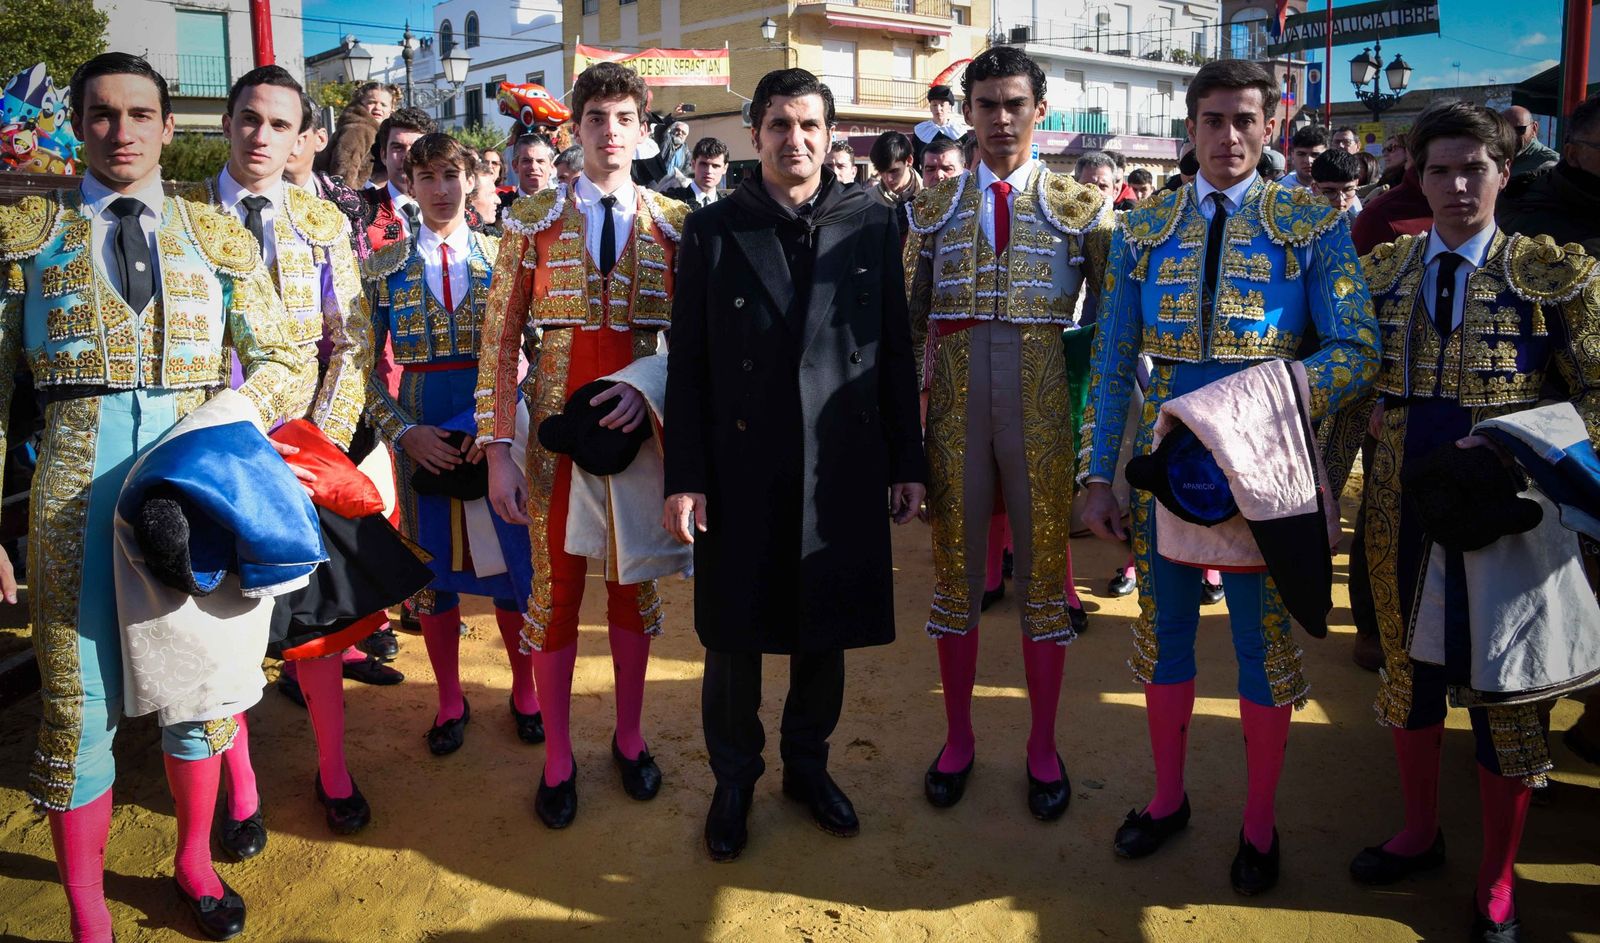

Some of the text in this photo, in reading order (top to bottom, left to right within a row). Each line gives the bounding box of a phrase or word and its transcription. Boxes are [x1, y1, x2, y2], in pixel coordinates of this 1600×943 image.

[1389, 6, 1435, 26] LIBRE
[641, 59, 652, 75] DE
[655, 59, 671, 75] SAN
[674, 59, 720, 75] SEBASTIAN
[1082, 135, 1097, 148] Las
